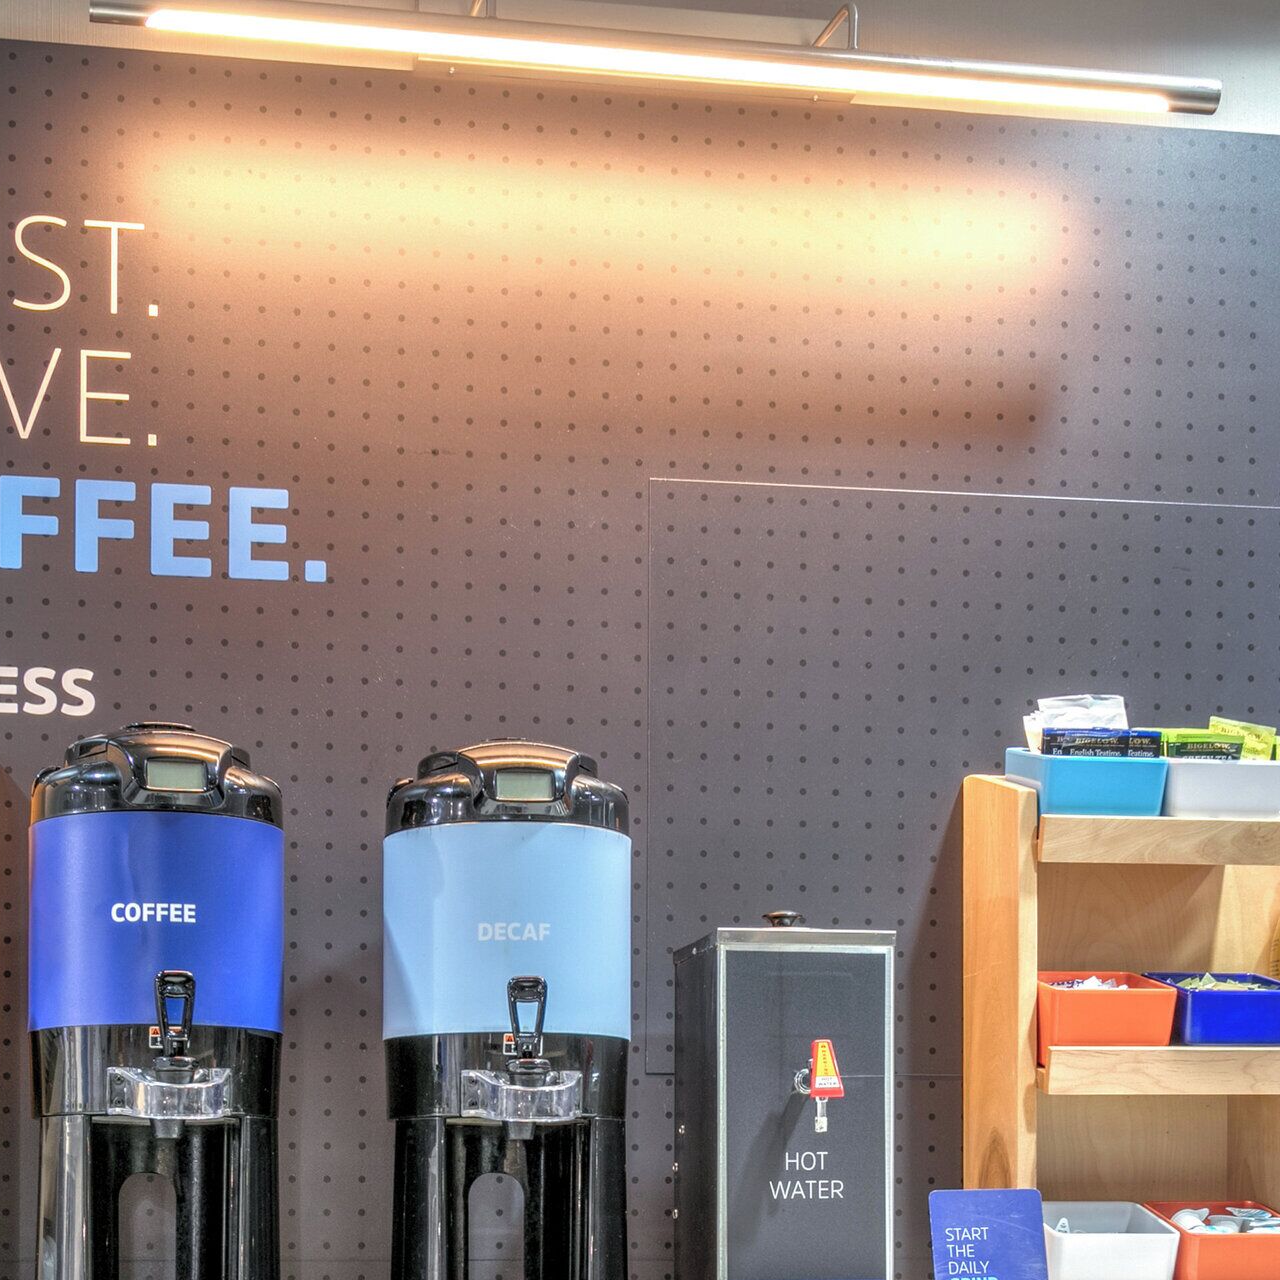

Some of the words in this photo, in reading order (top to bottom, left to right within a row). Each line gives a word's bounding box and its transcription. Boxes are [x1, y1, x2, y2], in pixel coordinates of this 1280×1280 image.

[110, 902, 196, 923] COFFEE
[477, 922, 551, 941] DECAF
[785, 1151, 828, 1171] HOT
[769, 1180, 844, 1199] WATER
[945, 1227, 989, 1242] START
[947, 1244, 975, 1258] THE
[948, 1261, 990, 1275] DAILY
